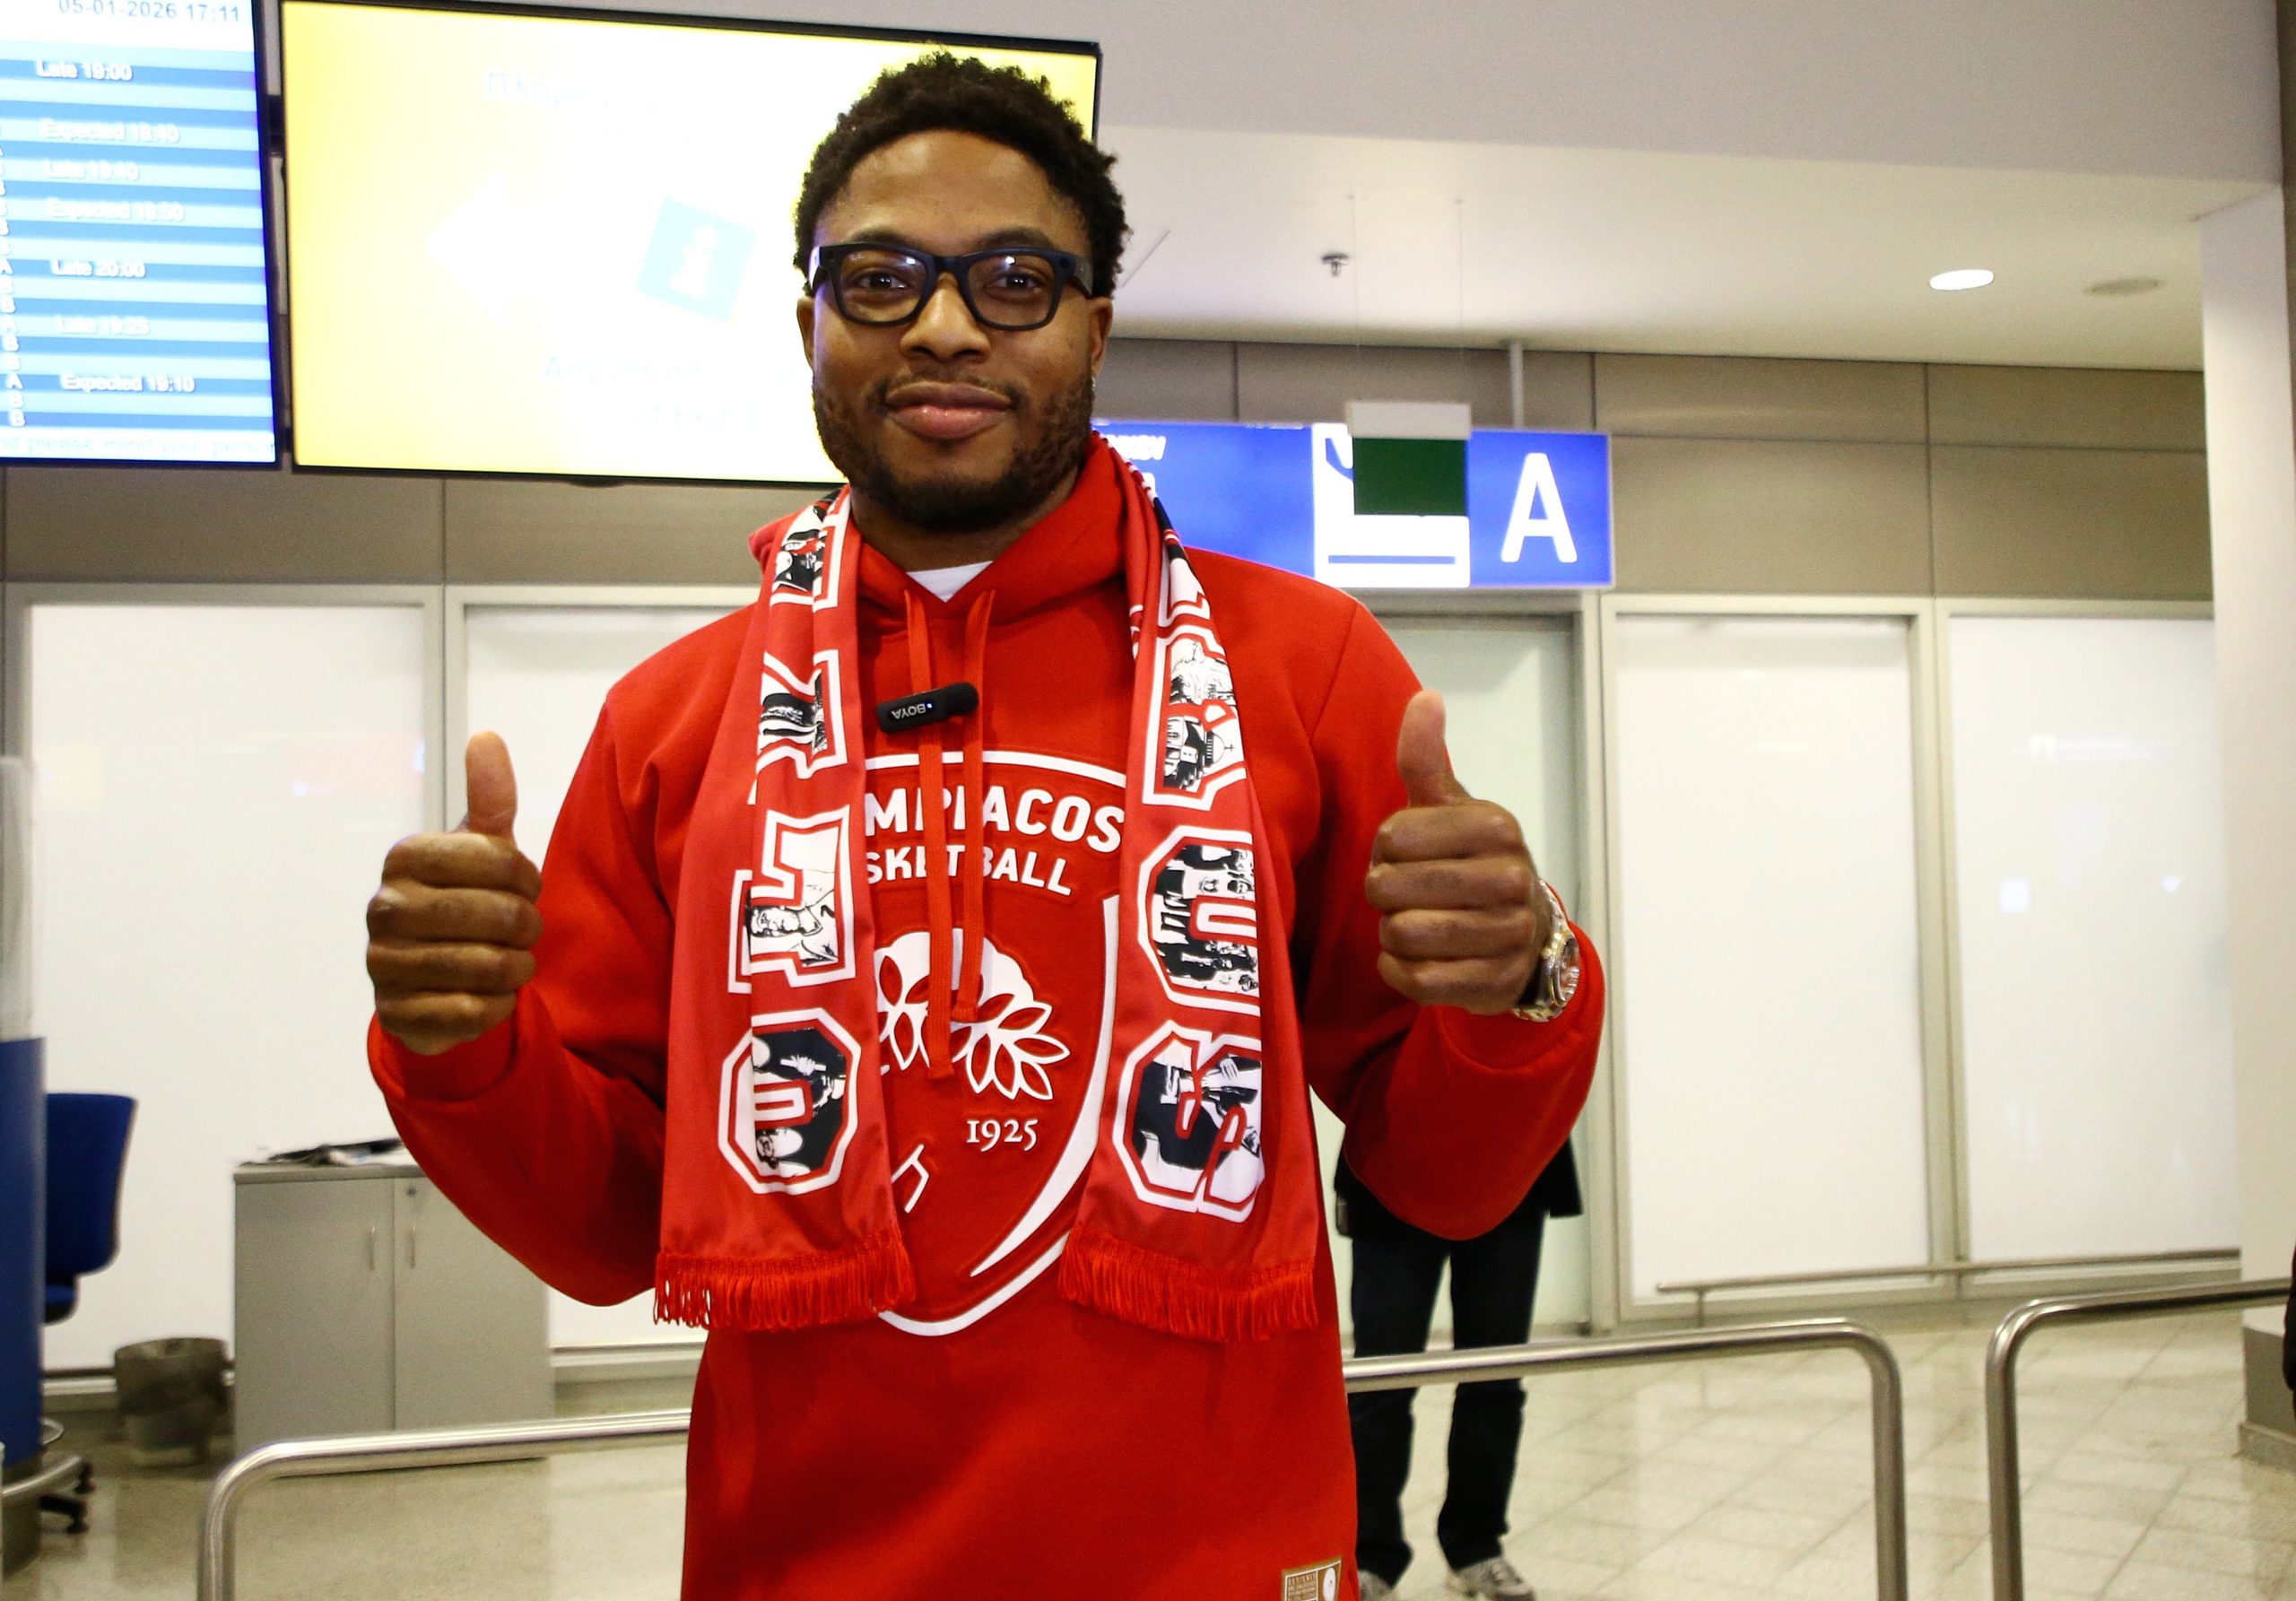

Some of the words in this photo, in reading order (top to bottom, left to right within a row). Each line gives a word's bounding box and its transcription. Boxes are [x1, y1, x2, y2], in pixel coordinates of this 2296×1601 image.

[58, 0, 177, 19] 05-01-2026
[187, 4, 239, 22] 17:11
[36, 60, 78, 78] Late
[82, 62, 133, 82] 19:00
[51, 259, 93, 276] Late
[96, 260, 146, 278] 20:00
[7, 375, 23, 390] A
[60, 372, 144, 394] Expected
[145, 376, 196, 393] 19:10
[9, 411, 25, 427] B
[1500, 452, 1578, 563] A
[891, 702, 927, 720] BOYA
[966, 1118, 1039, 1153] 1925
